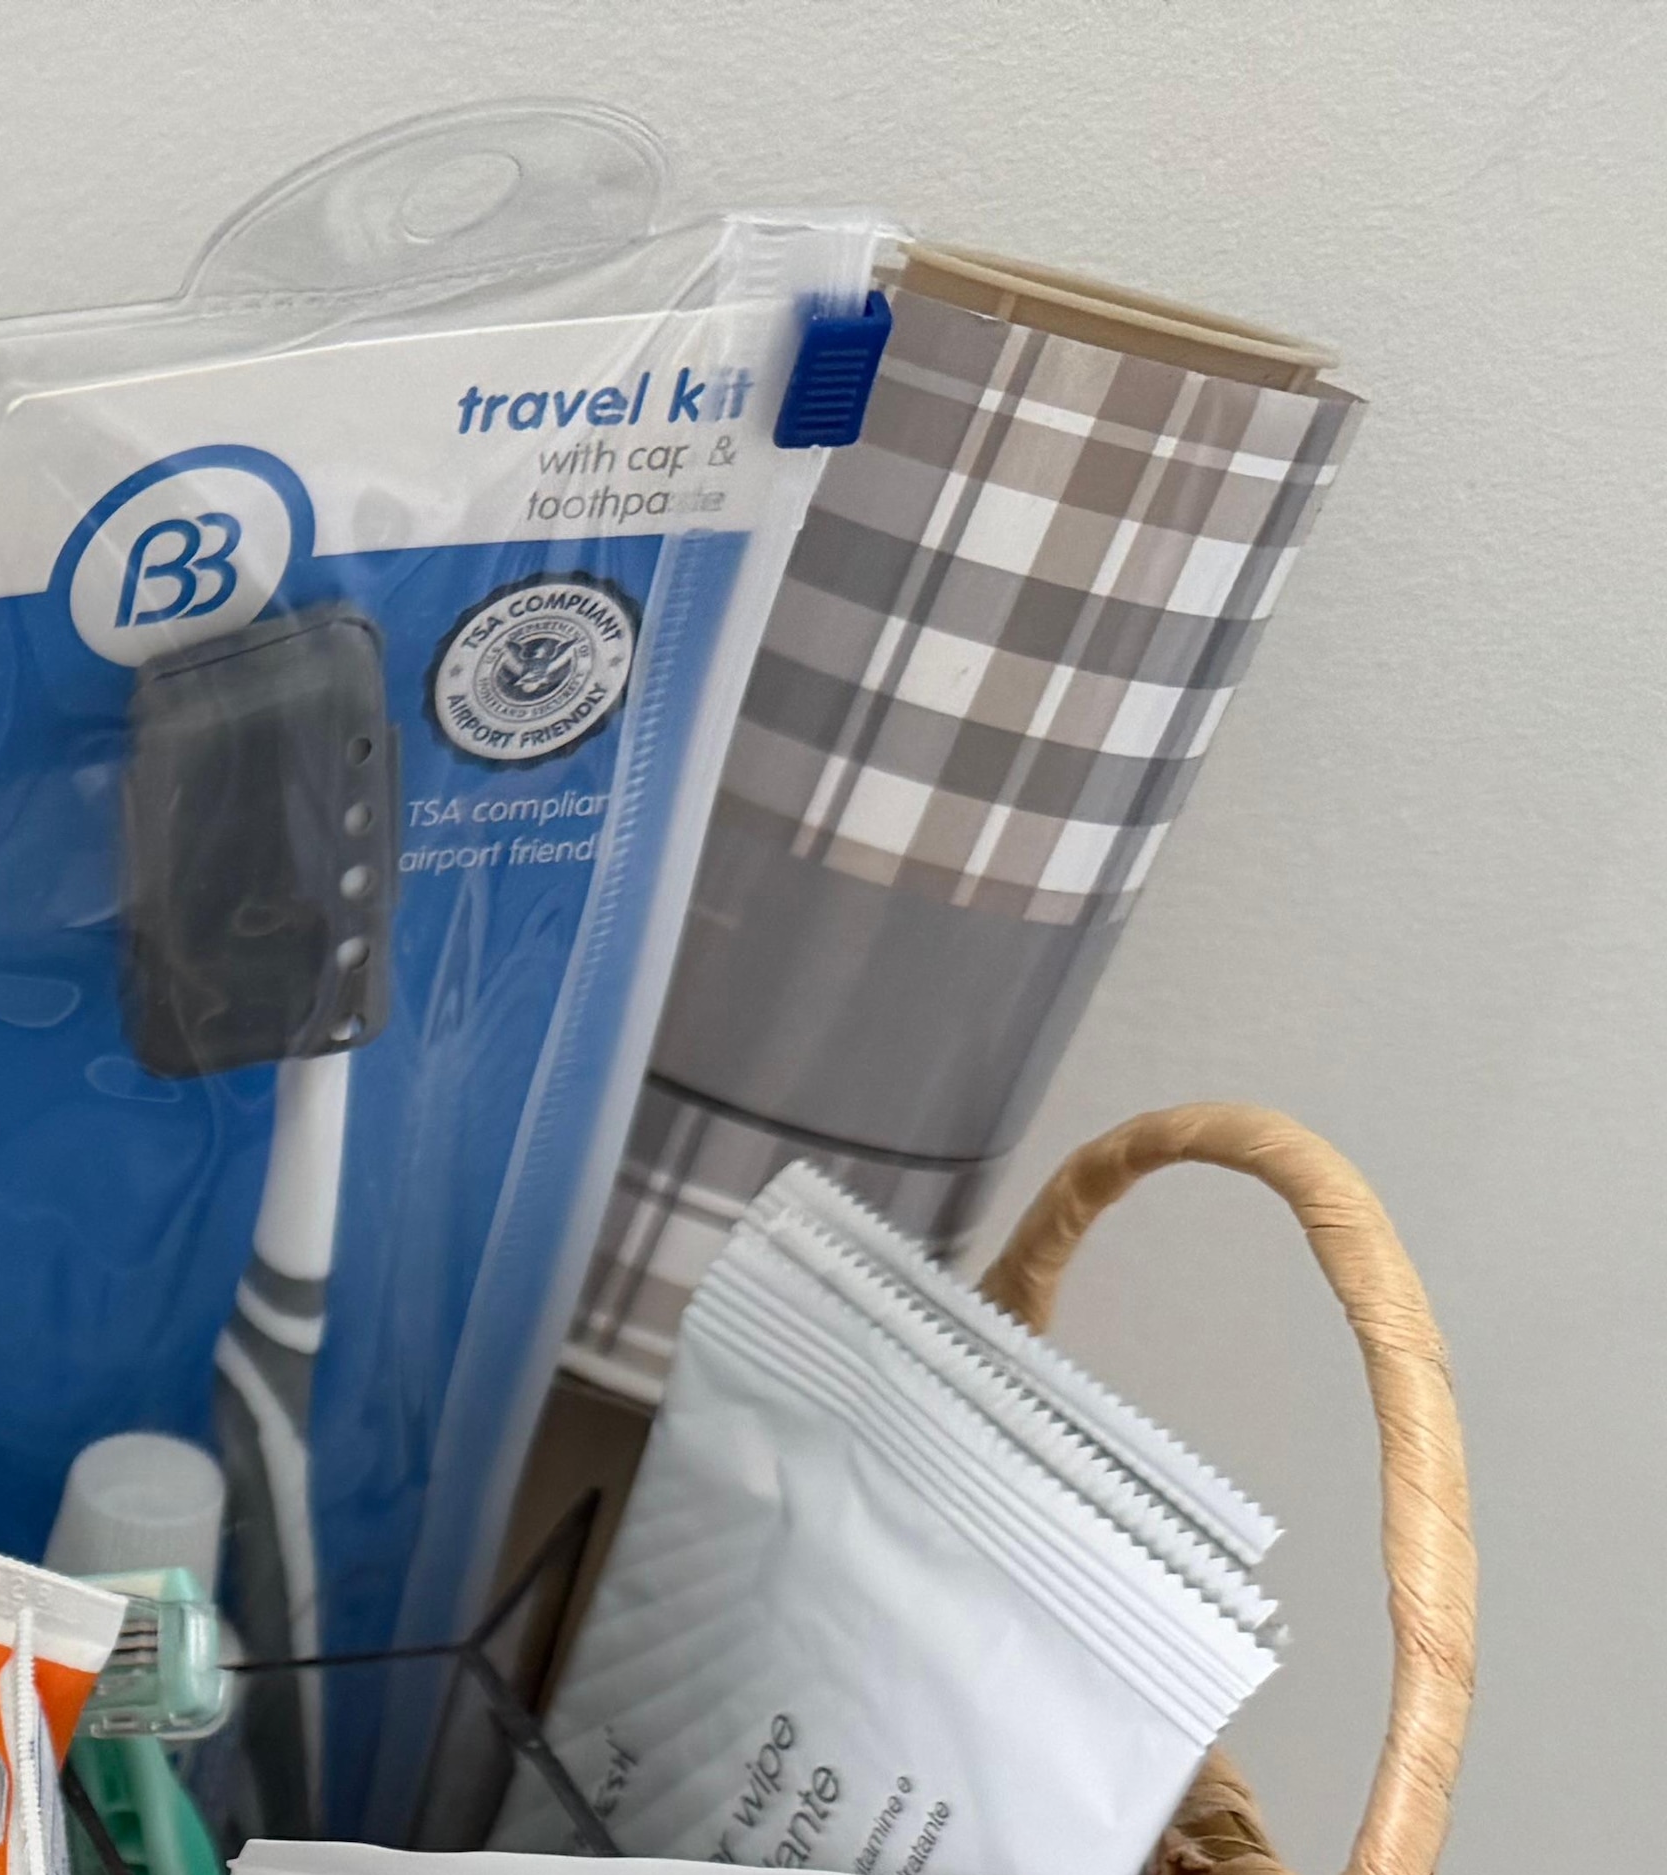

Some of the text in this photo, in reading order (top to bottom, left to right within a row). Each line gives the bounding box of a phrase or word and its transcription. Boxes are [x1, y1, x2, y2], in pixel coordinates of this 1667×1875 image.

[457, 366, 756, 435] travel kit
[538, 439, 616, 475] with
[525, 485, 727, 525] toothpate
[461, 592, 623, 652] TSA COMPLIANT
[446, 682, 608, 749] AIRPORT FRIENDLY
[408, 791, 612, 828] TSA complian
[398, 832, 601, 876] airport friend
[732, 1713, 795, 1828] wipe
[854, 1794, 904, 1875] itamine
